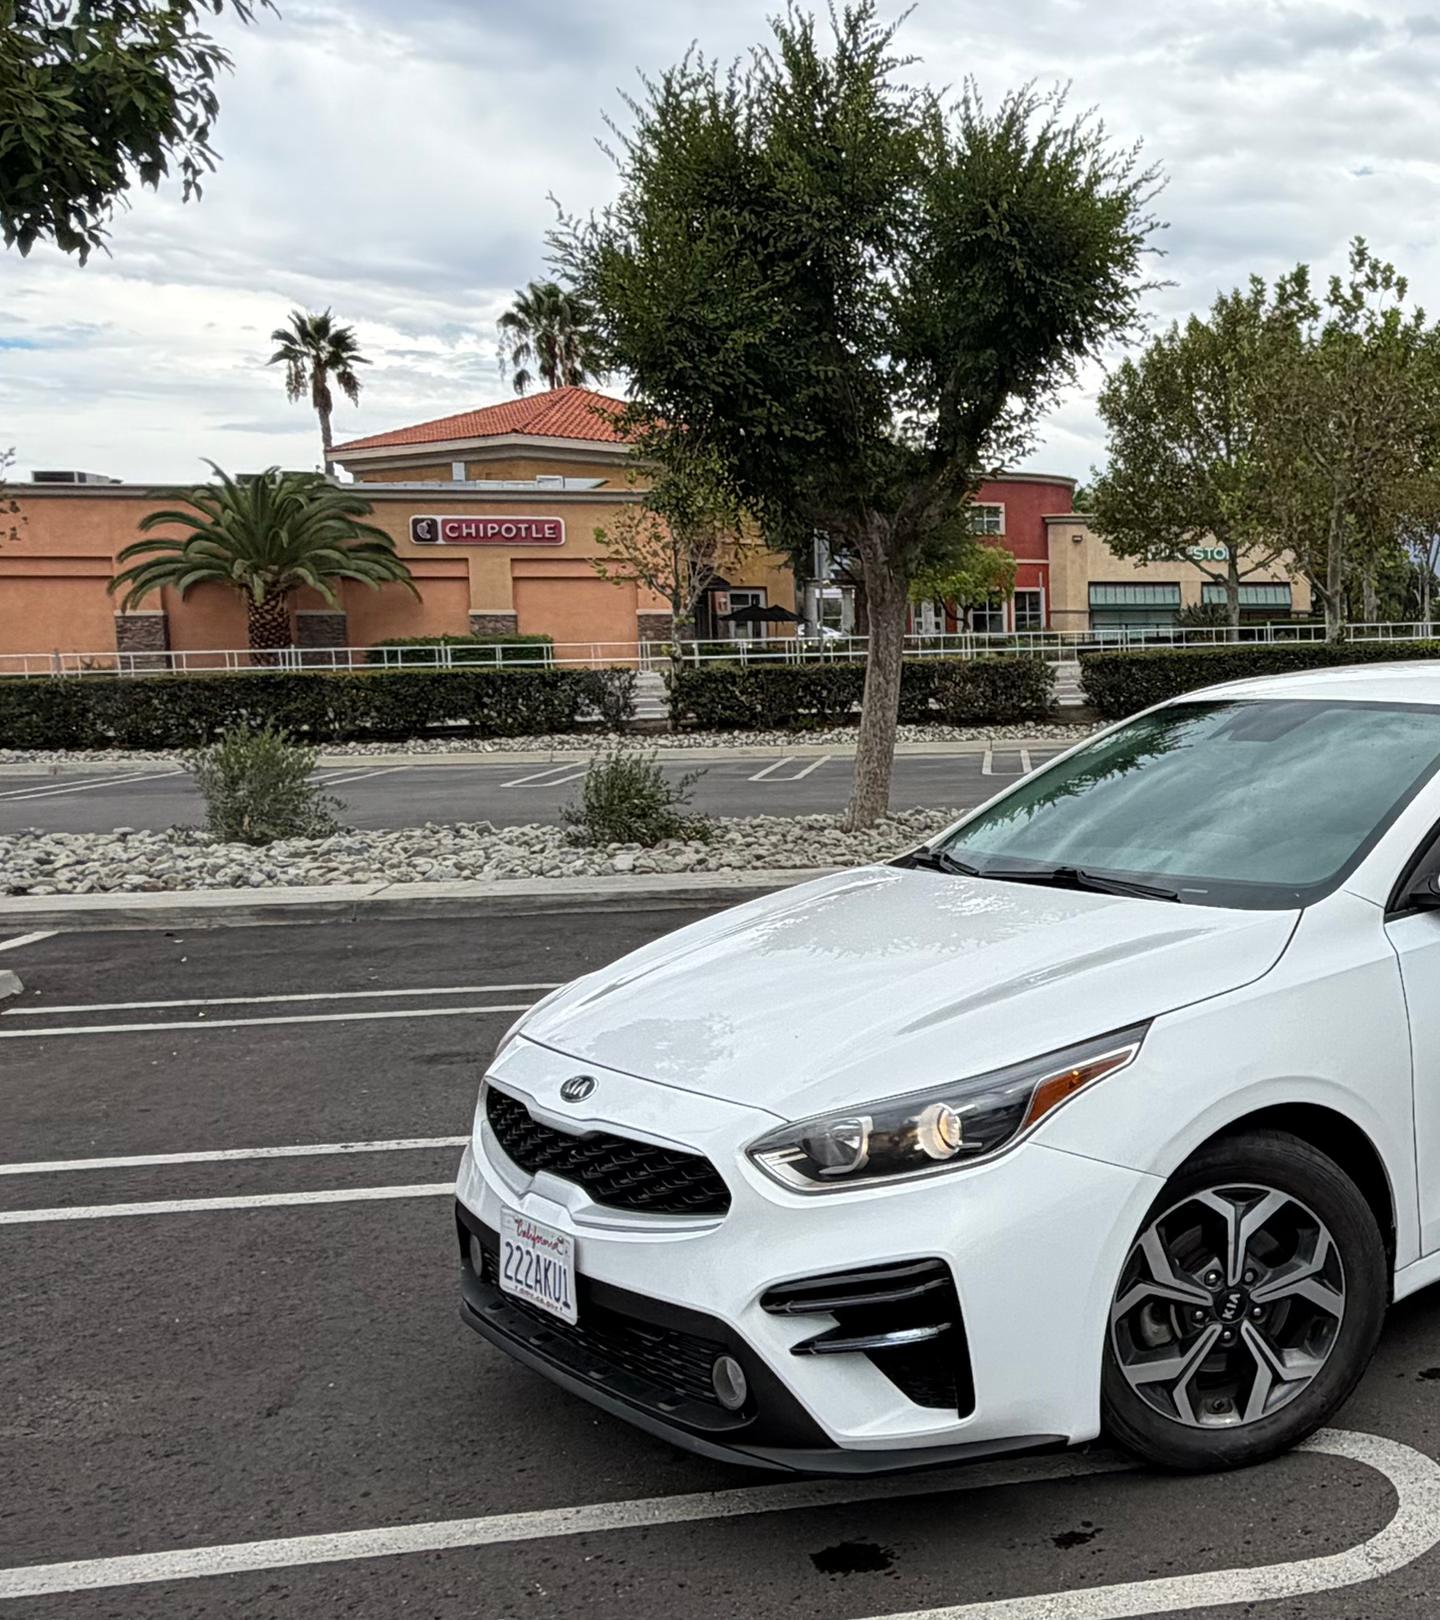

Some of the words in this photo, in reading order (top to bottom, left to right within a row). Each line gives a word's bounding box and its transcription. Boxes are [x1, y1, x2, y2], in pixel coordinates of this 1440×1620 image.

[445, 523, 557, 538] CHIPOTLE
[563, 1078, 591, 1097] KIA
[513, 1217, 563, 1255] California
[504, 1241, 571, 1310] 222AKU1
[1222, 1293, 1241, 1319] KIA
